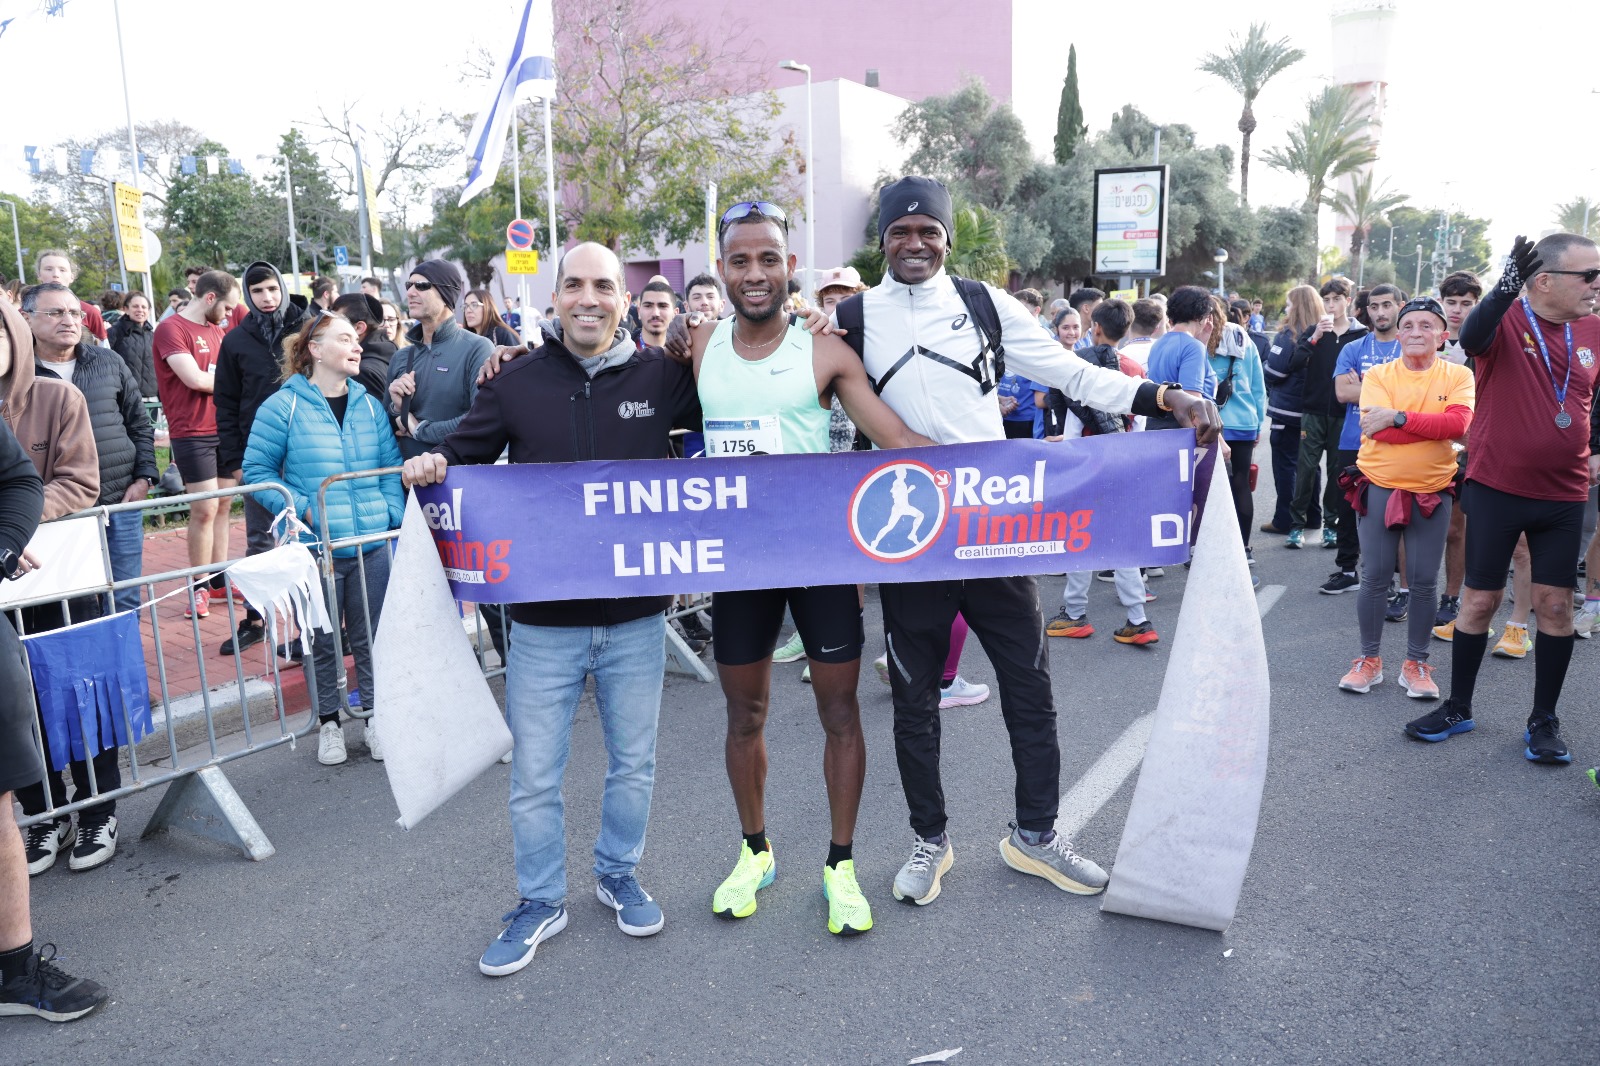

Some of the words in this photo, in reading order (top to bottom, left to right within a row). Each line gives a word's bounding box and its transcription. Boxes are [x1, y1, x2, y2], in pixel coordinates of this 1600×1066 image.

[1115, 194, 1148, 208] נפגשים
[634, 400, 648, 409] Real
[722, 440, 755, 453] 1756
[583, 475, 748, 516] FINISH
[952, 460, 1047, 507] Real
[422, 488, 463, 531] eal
[952, 502, 1093, 553] Timing
[435, 531, 512, 584] ming
[613, 539, 725, 577] LINE
[958, 542, 1058, 559] realtiming.co.il
